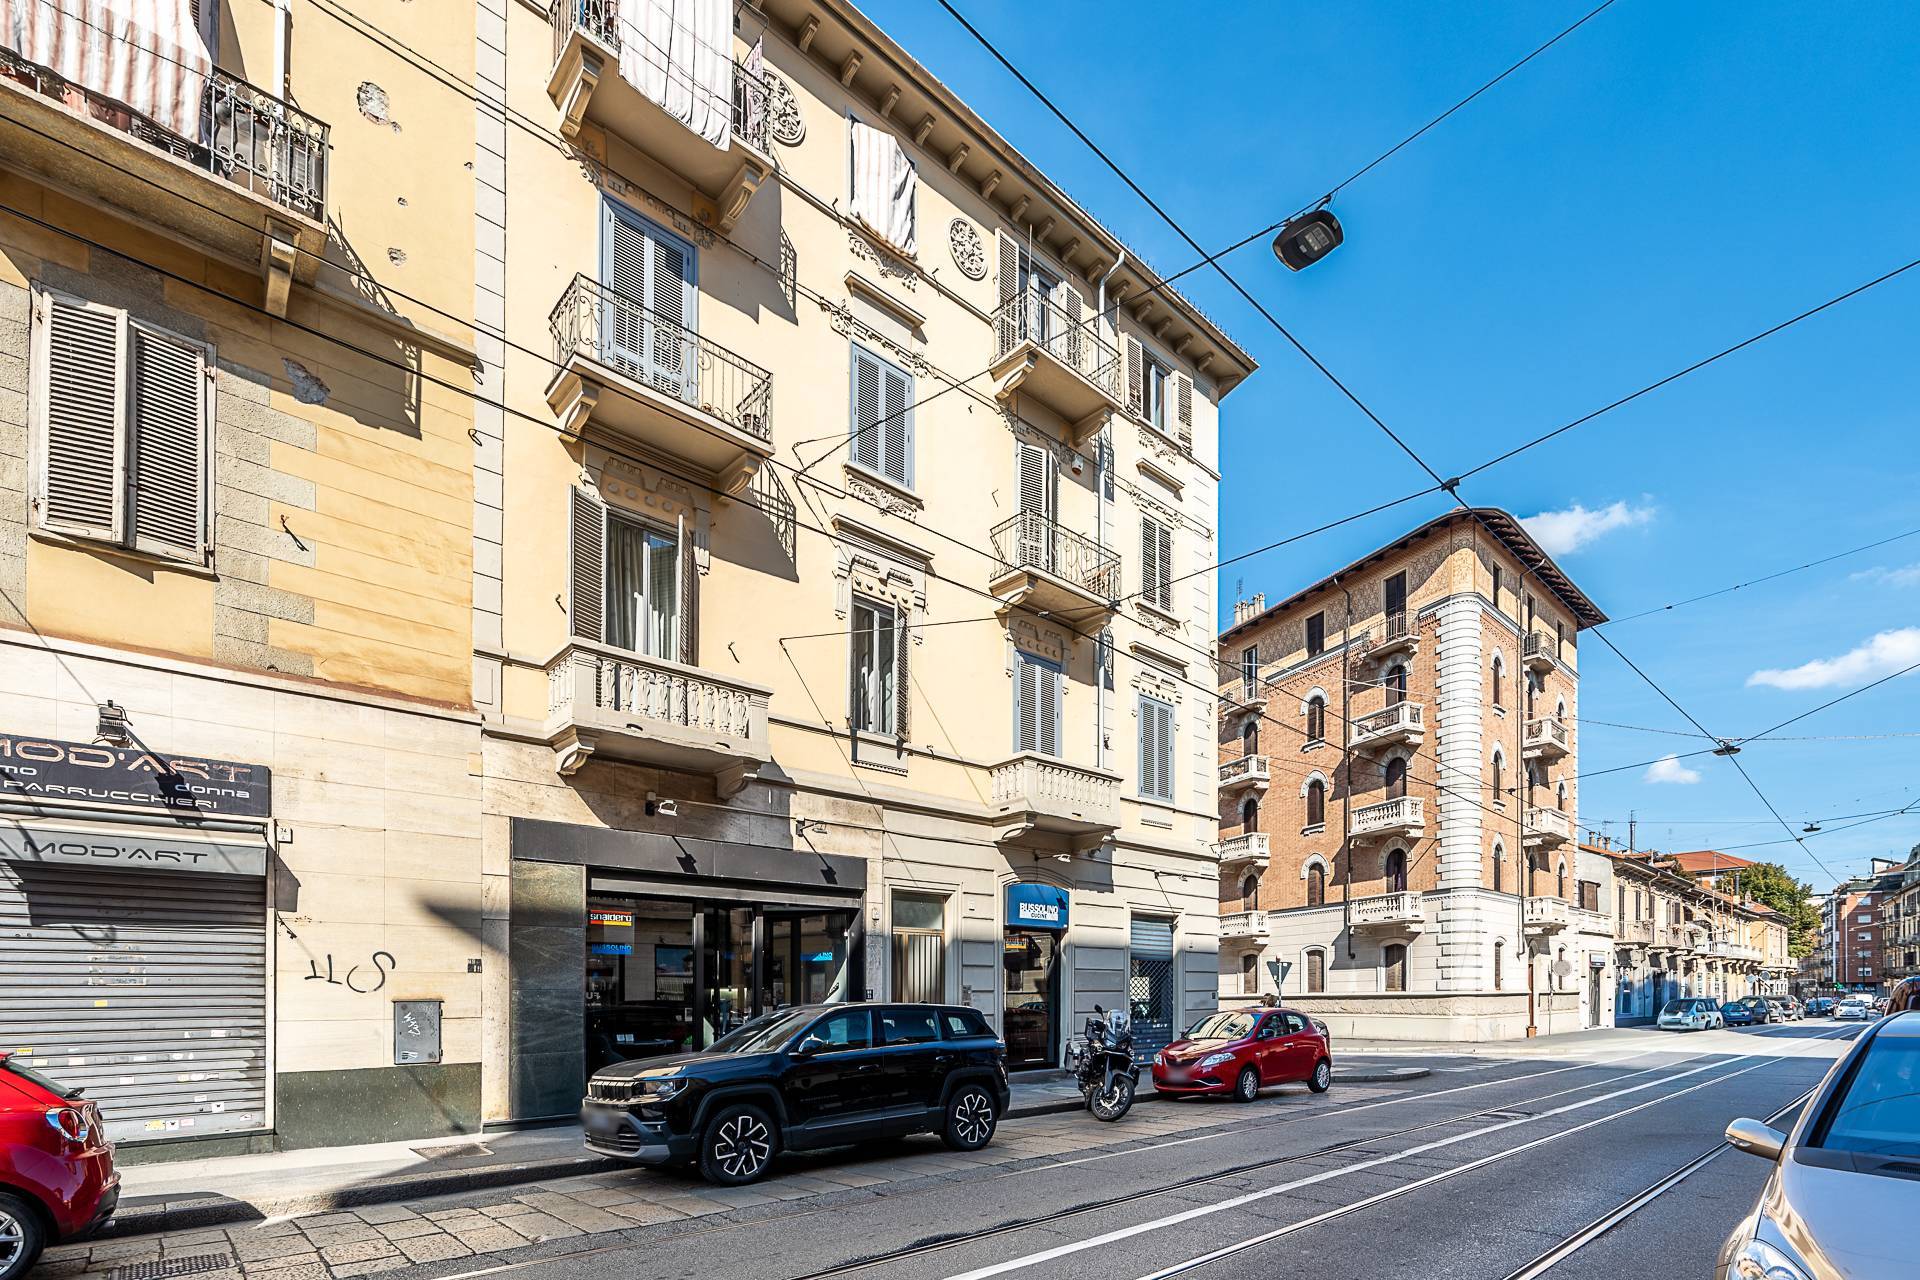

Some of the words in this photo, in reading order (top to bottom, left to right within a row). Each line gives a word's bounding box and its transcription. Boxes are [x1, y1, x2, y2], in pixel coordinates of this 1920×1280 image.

[3, 780, 217, 809] PARRUCCHIERI
[175, 782, 250, 799] donna
[23, 840, 208, 864] MOD'ART
[1020, 902, 1058, 914] BUSSOLINO
[590, 913, 632, 922] snaidero
